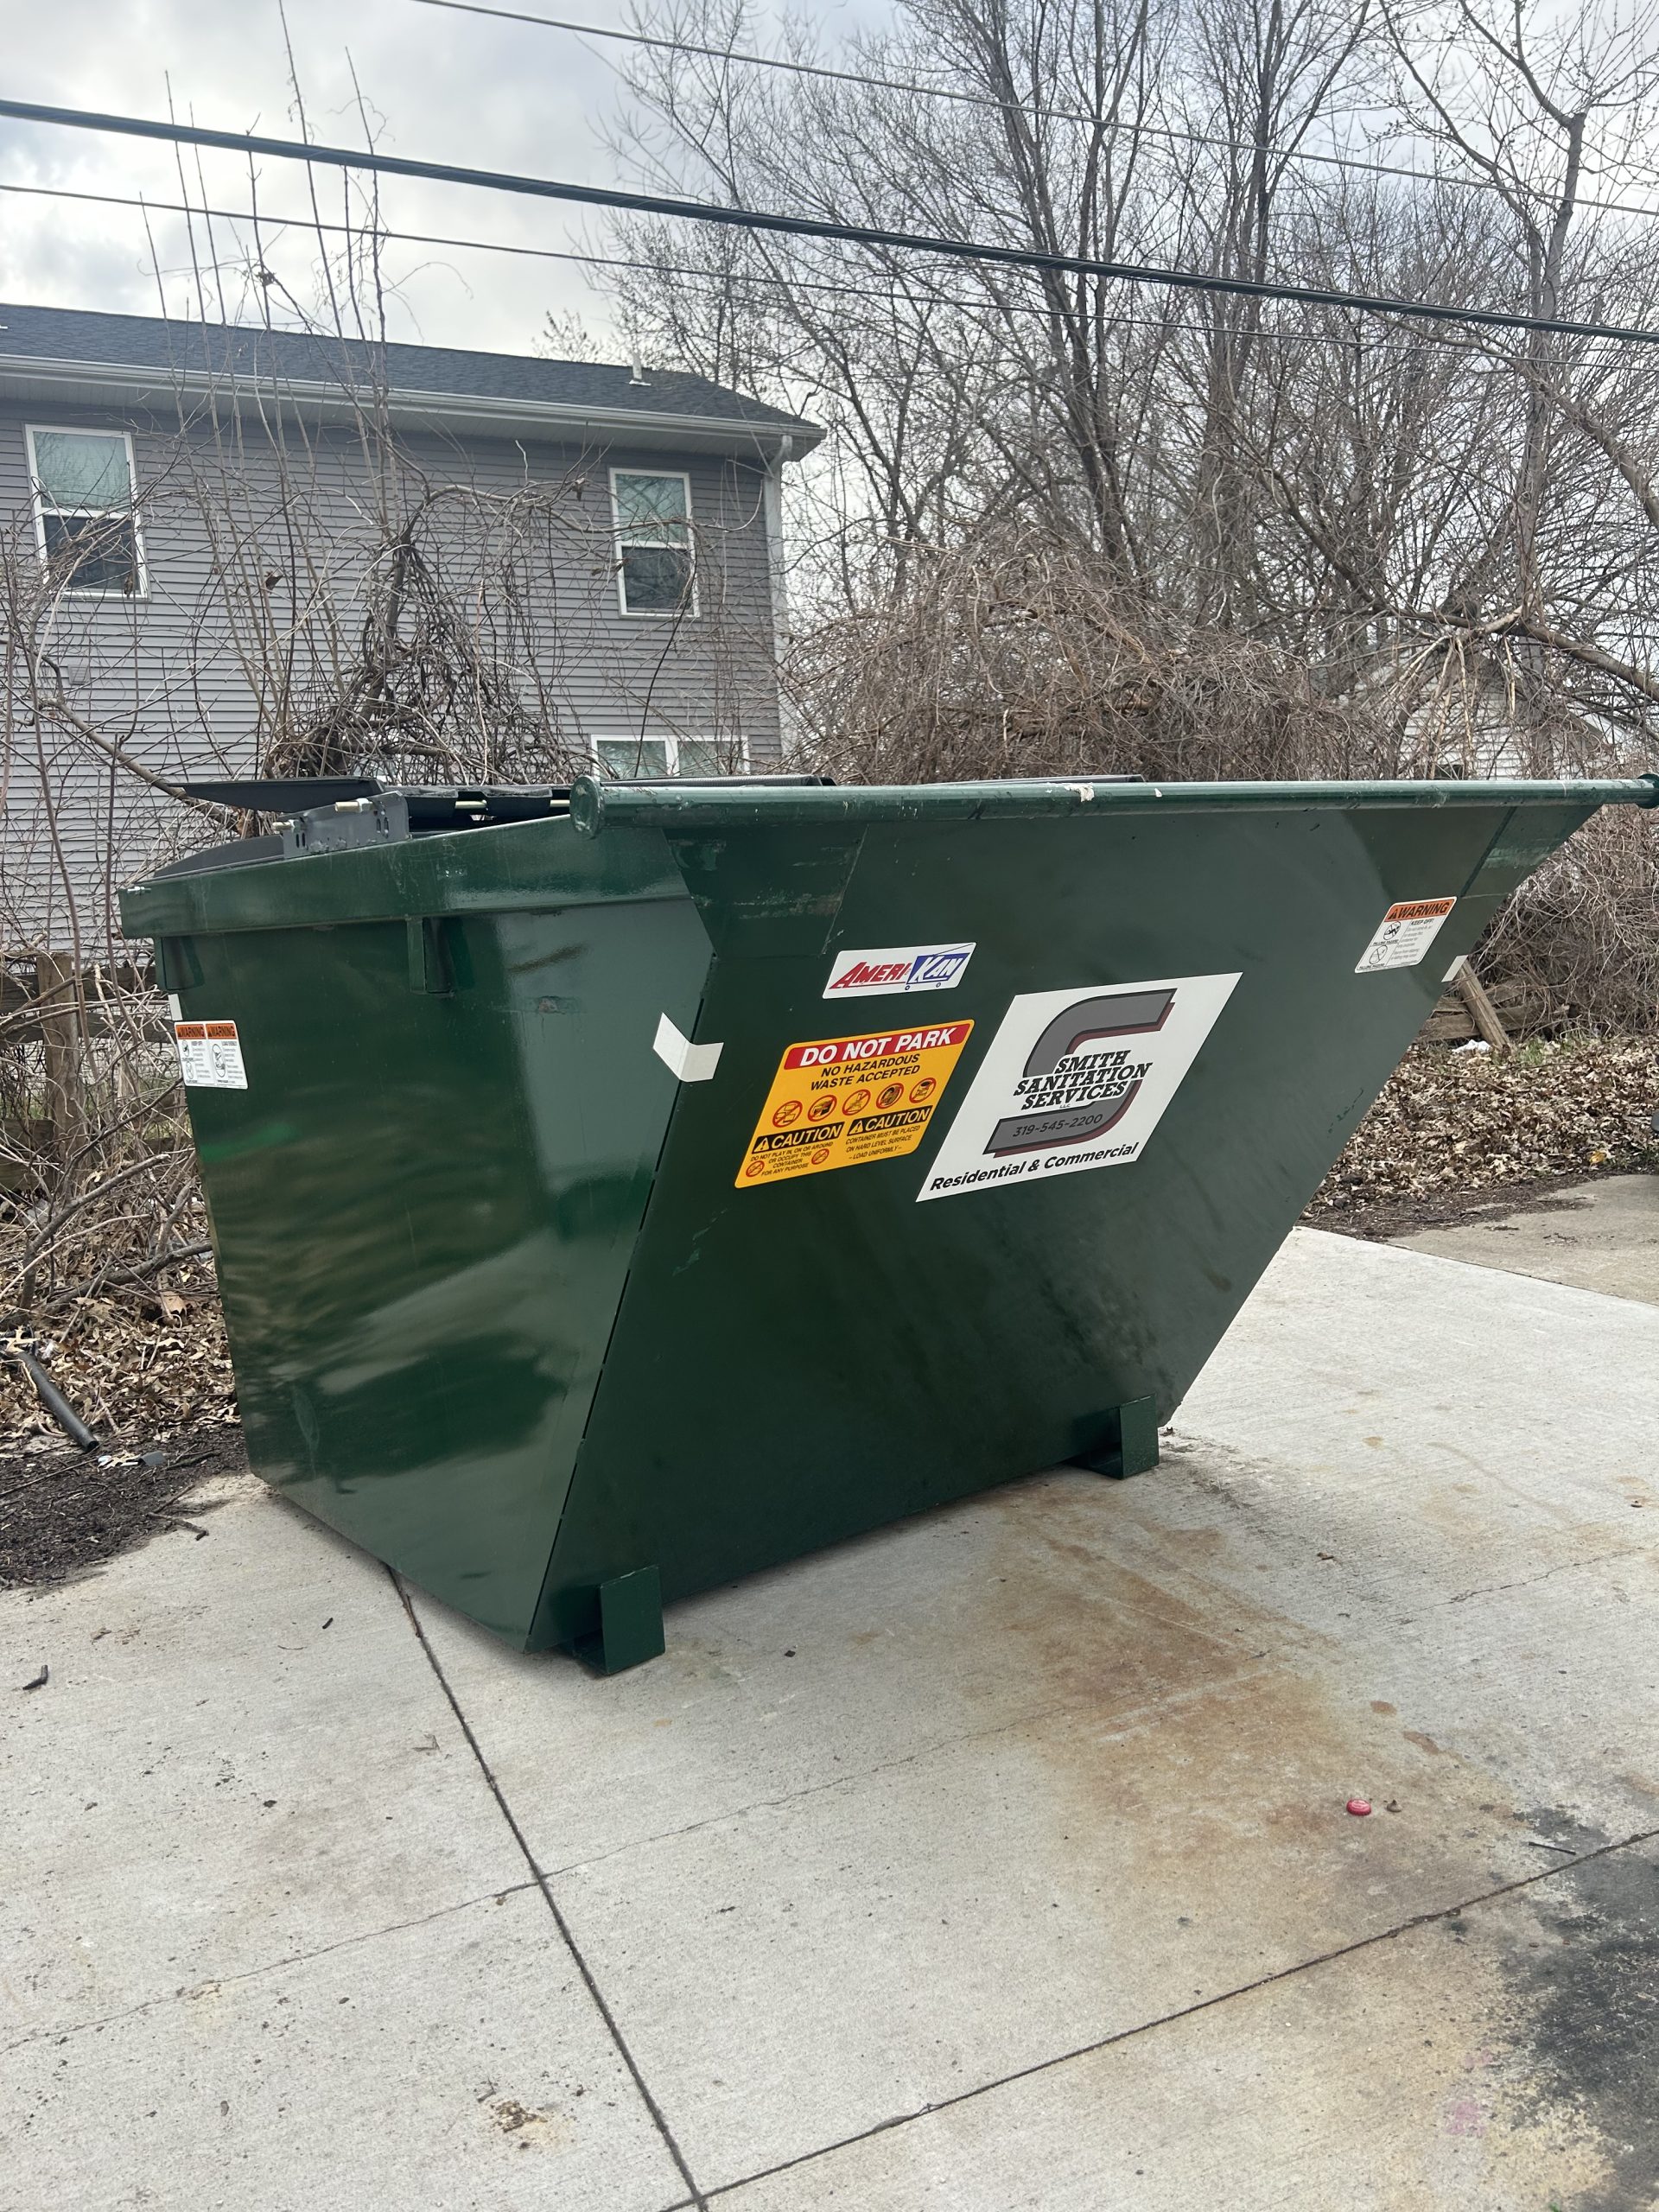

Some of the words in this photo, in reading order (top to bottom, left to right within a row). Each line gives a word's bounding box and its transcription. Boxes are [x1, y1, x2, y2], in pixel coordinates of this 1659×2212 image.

[1397, 902, 1449, 918] WARNING
[800, 1047, 837, 1066] DO
[842, 1038, 892, 1060] NOT
[895, 1027, 957, 1052] PARK
[821, 1066, 841, 1077] NO
[843, 1053, 920, 1074] HAZARDOUS
[1054, 1050, 1131, 1074] SMITH
[810, 1077, 854, 1091] WASTE
[856, 1065, 921, 1084] ACCEPTED
[1013, 1063, 1154, 1096] SANITATION
[1020, 1081, 1127, 1110] SERVICES
[865, 1108, 931, 1131] CAUTION
[772, 1124, 842, 1149] CAUTION
[846, 1133, 876, 1145] CONTAINER
[930, 1161, 1027, 1192] Residential
[1027, 1159, 1040, 1173] &
[1044, 1142, 1140, 1169] Commercial
